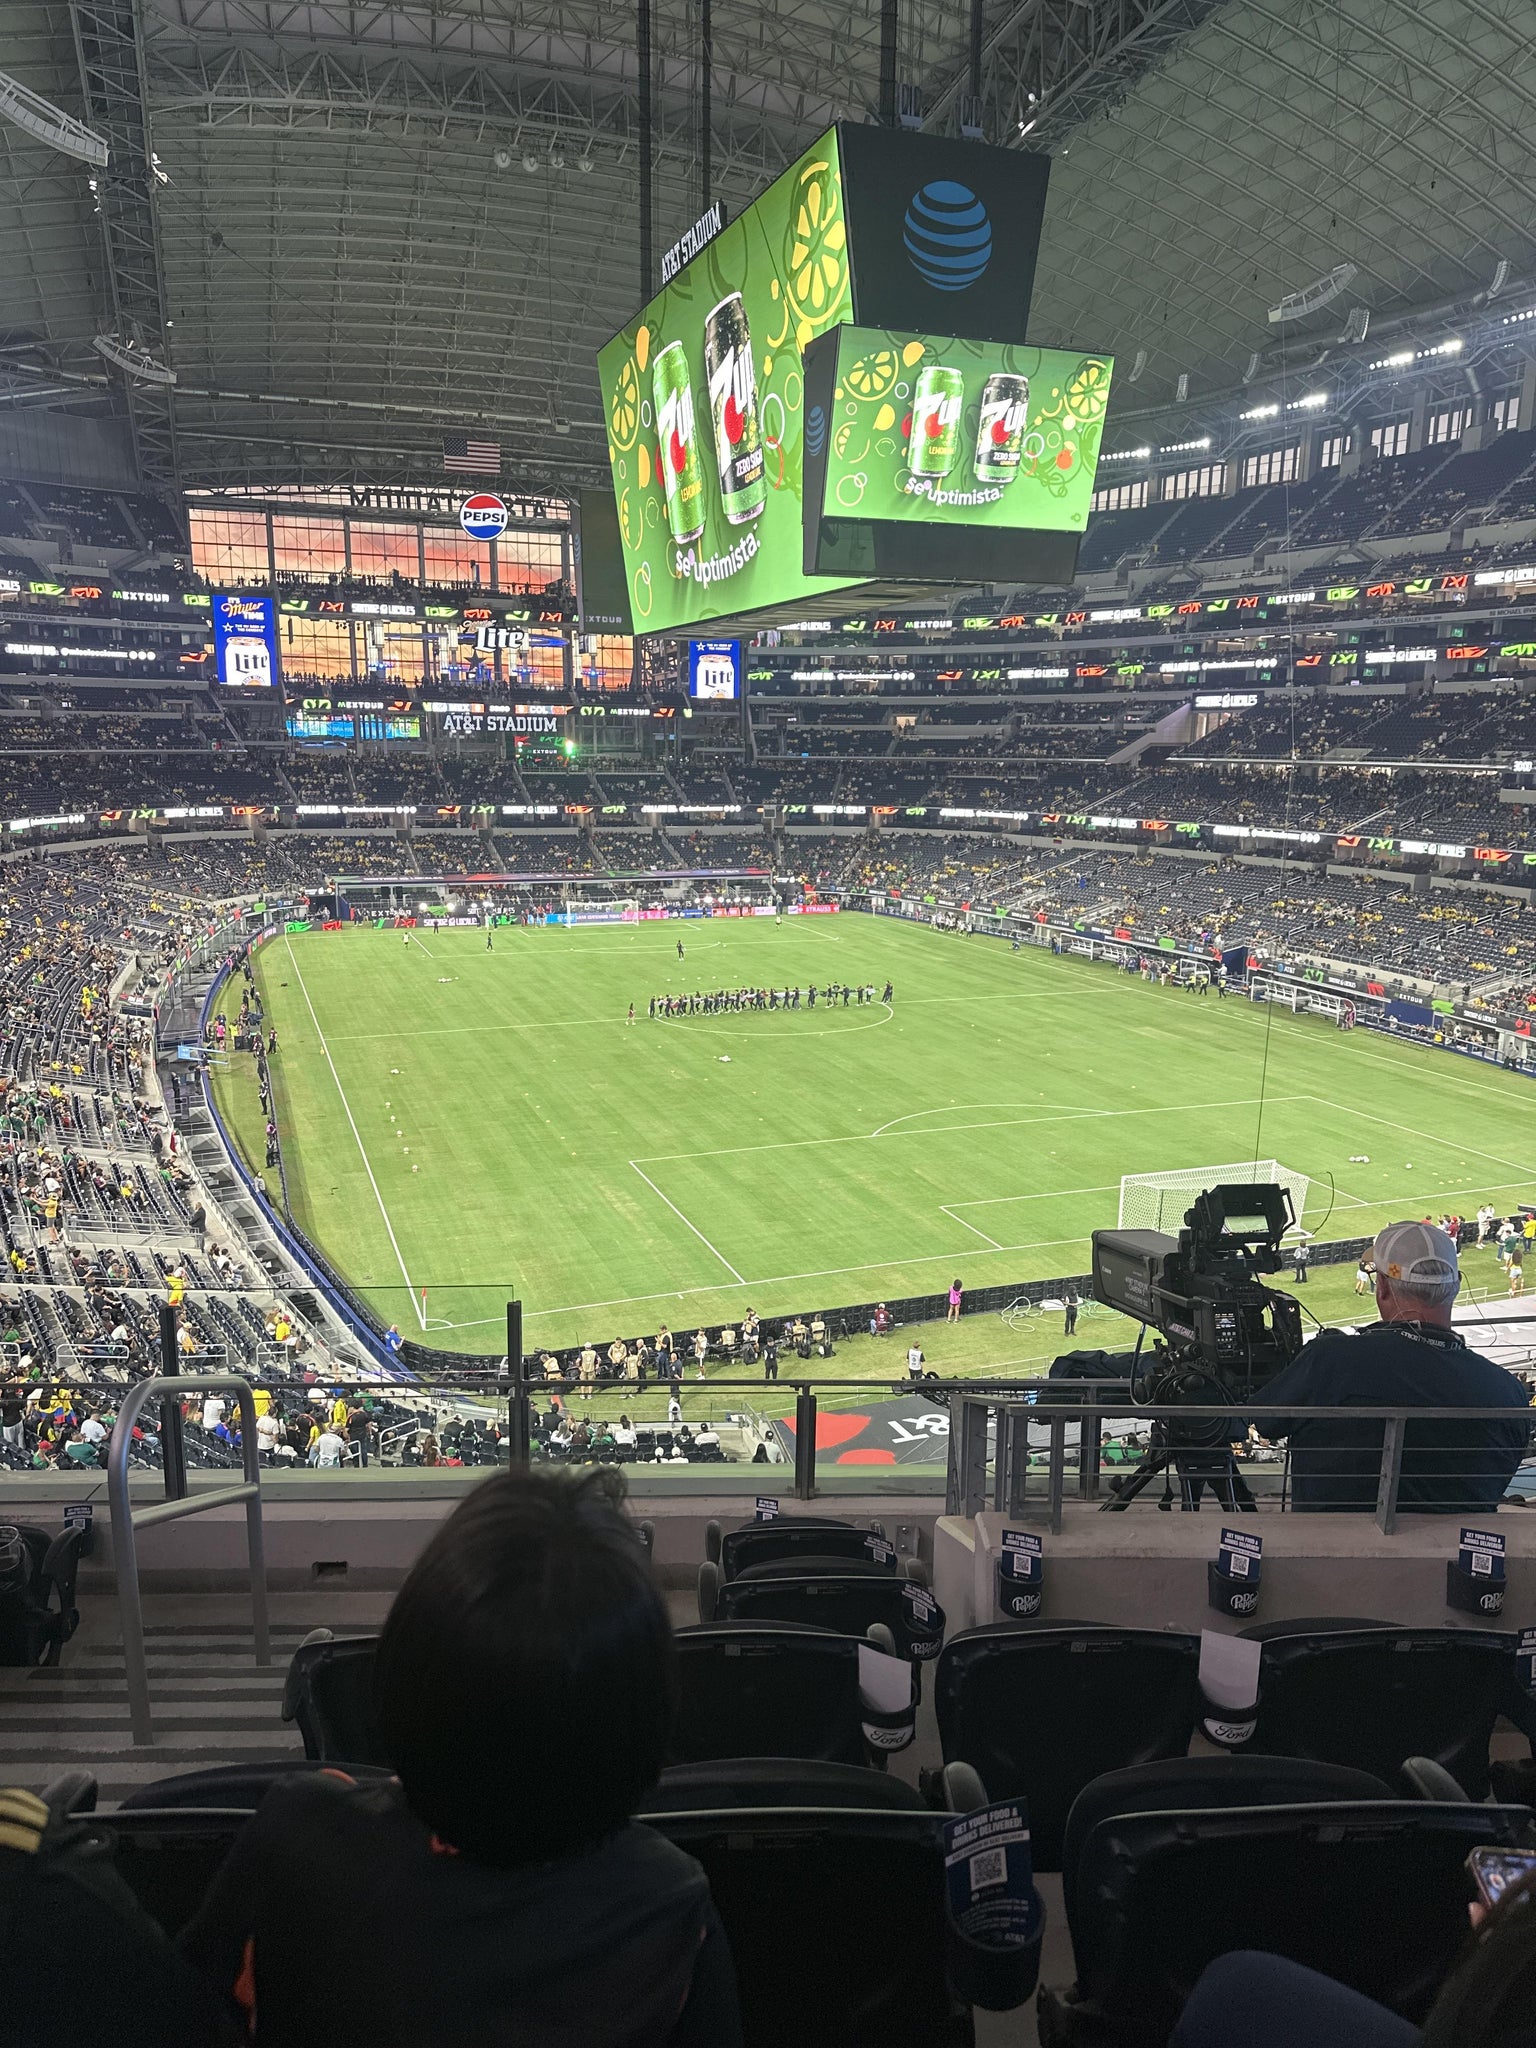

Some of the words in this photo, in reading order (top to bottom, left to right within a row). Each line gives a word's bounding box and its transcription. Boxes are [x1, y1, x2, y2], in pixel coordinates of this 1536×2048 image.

[661, 242, 681, 285] AT&T
[681, 201, 722, 265] STADIUM
[463, 511, 505, 523] PEPSI
[112, 590, 170, 603] MEXTOUR
[221, 602, 264, 618] Miller
[905, 620, 952, 629] MEXTOUR
[475, 626, 523, 653] Lite
[235, 653, 268, 674] Lite
[705, 669, 732, 688] Lite
[338, 701, 383, 709] MEXTOUR
[443, 714, 483, 731] AT&T
[487, 716, 558, 732] STADIUM
[870, 1729, 904, 1745] Ford
[1215, 1725, 1252, 1739] Ford
[953, 1822, 967, 1836] GET
[968, 1813, 988, 1829] YOUR
[989, 1808, 1010, 1823] FOOD
[979, 1817, 1023, 1837] DELIVERED!
